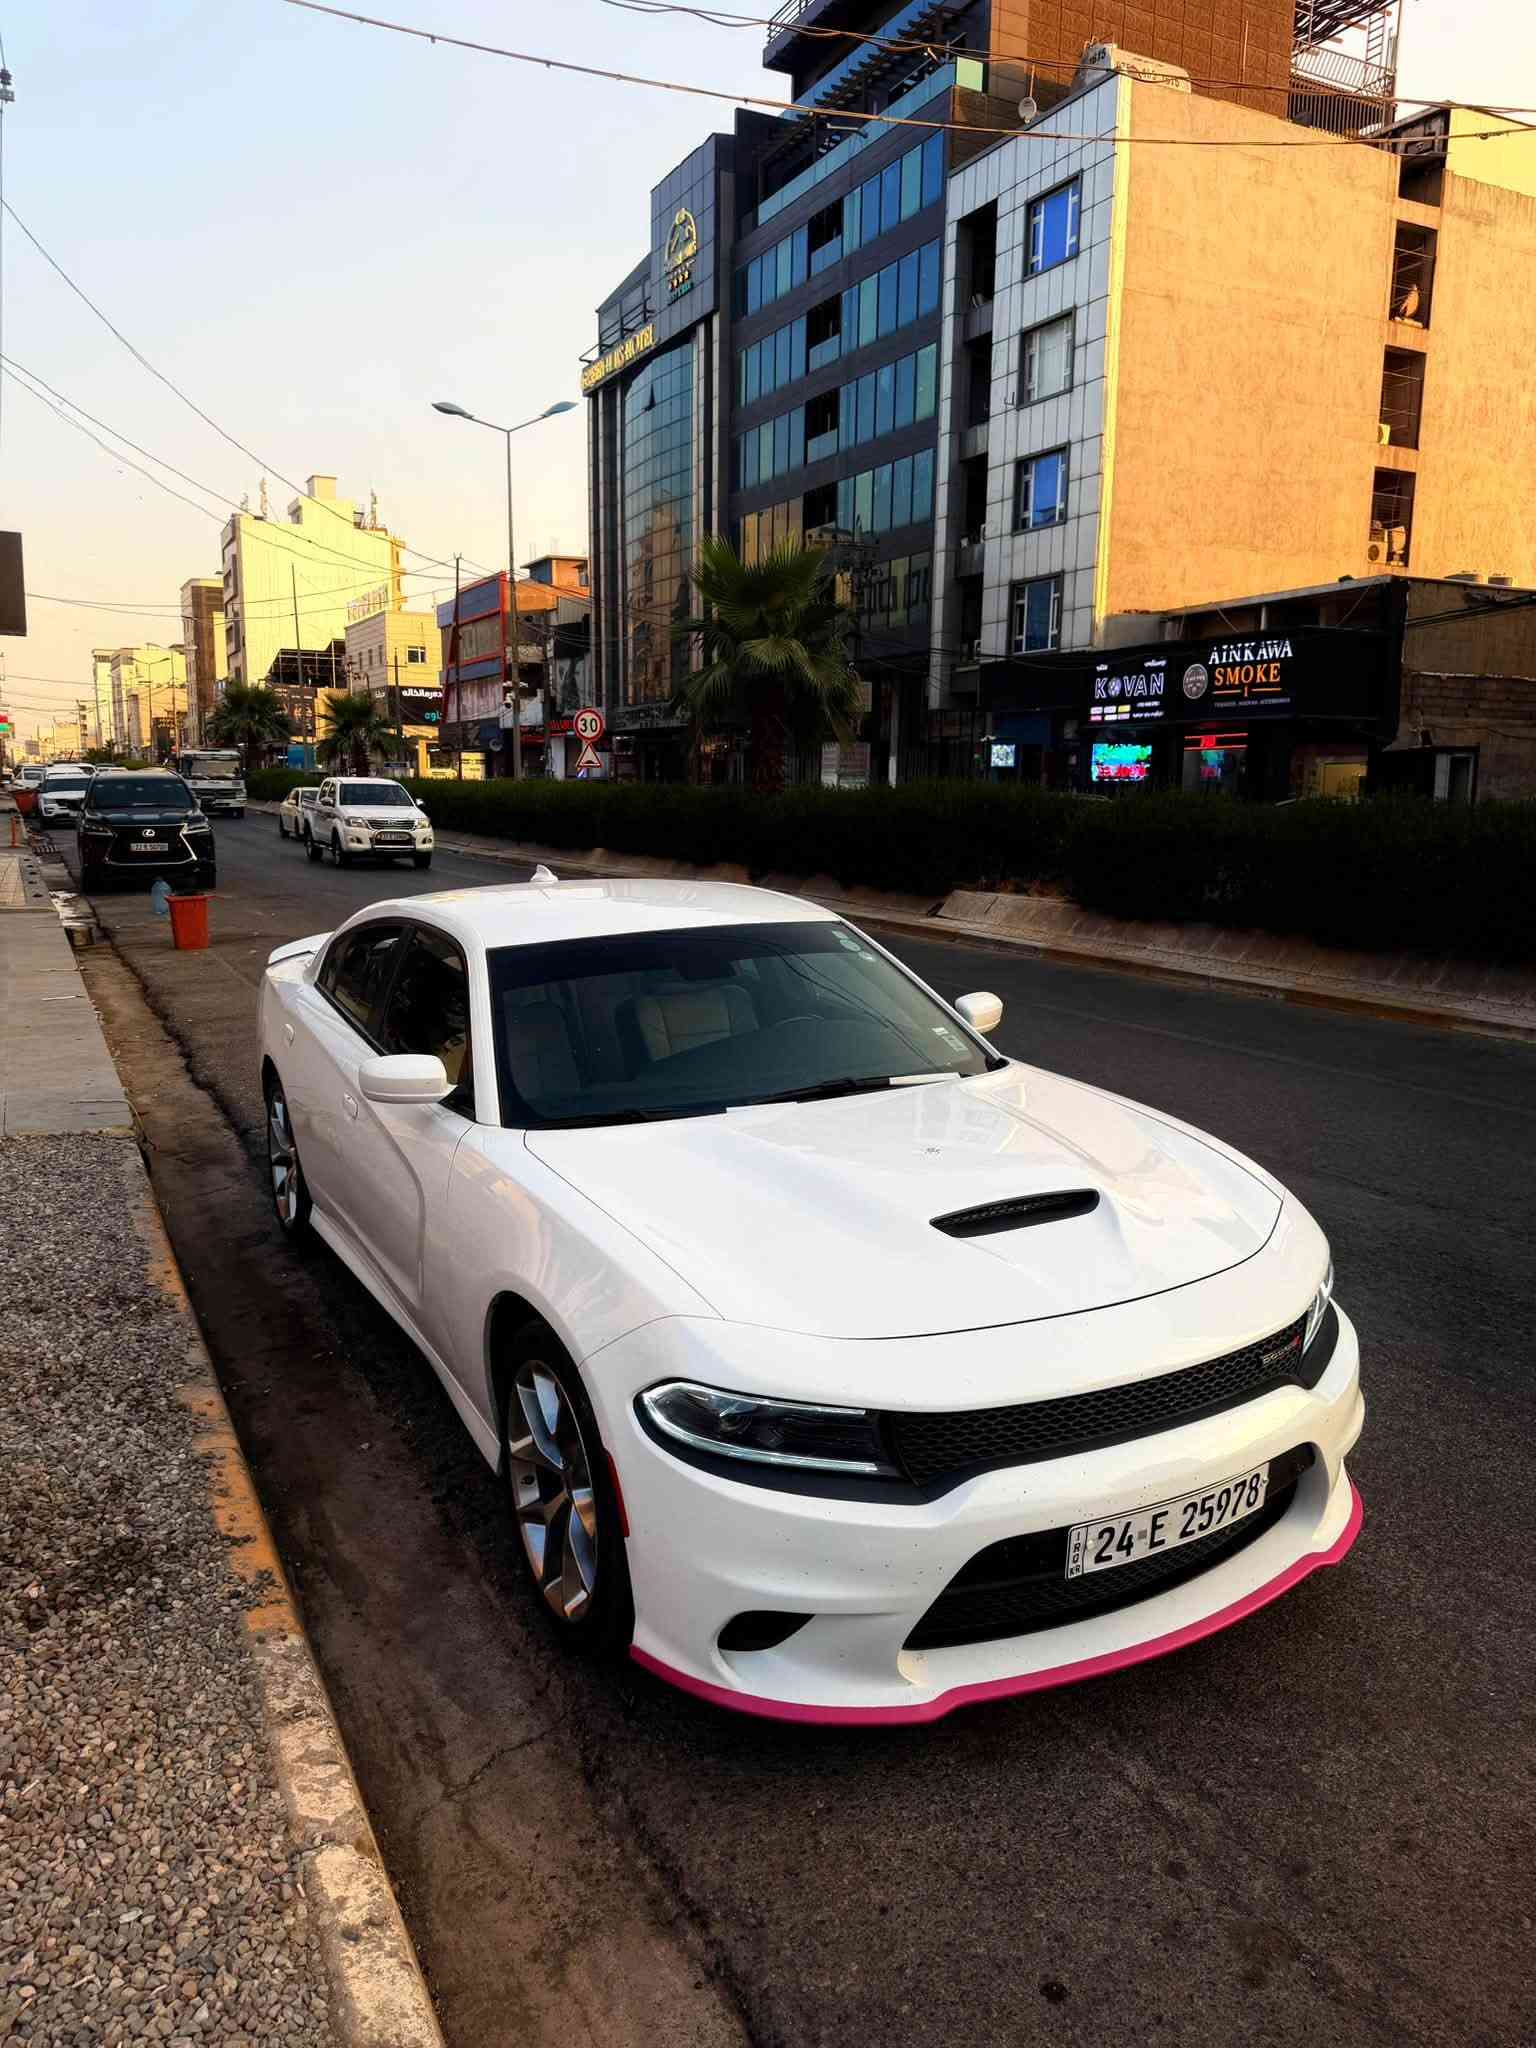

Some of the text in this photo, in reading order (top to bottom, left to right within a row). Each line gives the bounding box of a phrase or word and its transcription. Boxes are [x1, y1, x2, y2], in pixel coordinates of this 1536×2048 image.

[1208, 638, 1293, 665] AINKAWA
[1094, 672, 1165, 699] KOVAN
[1214, 662, 1281, 686] SMOKE
[580, 718, 598, 732] 30
[1094, 1472, 1262, 1564] 24 E 25978
